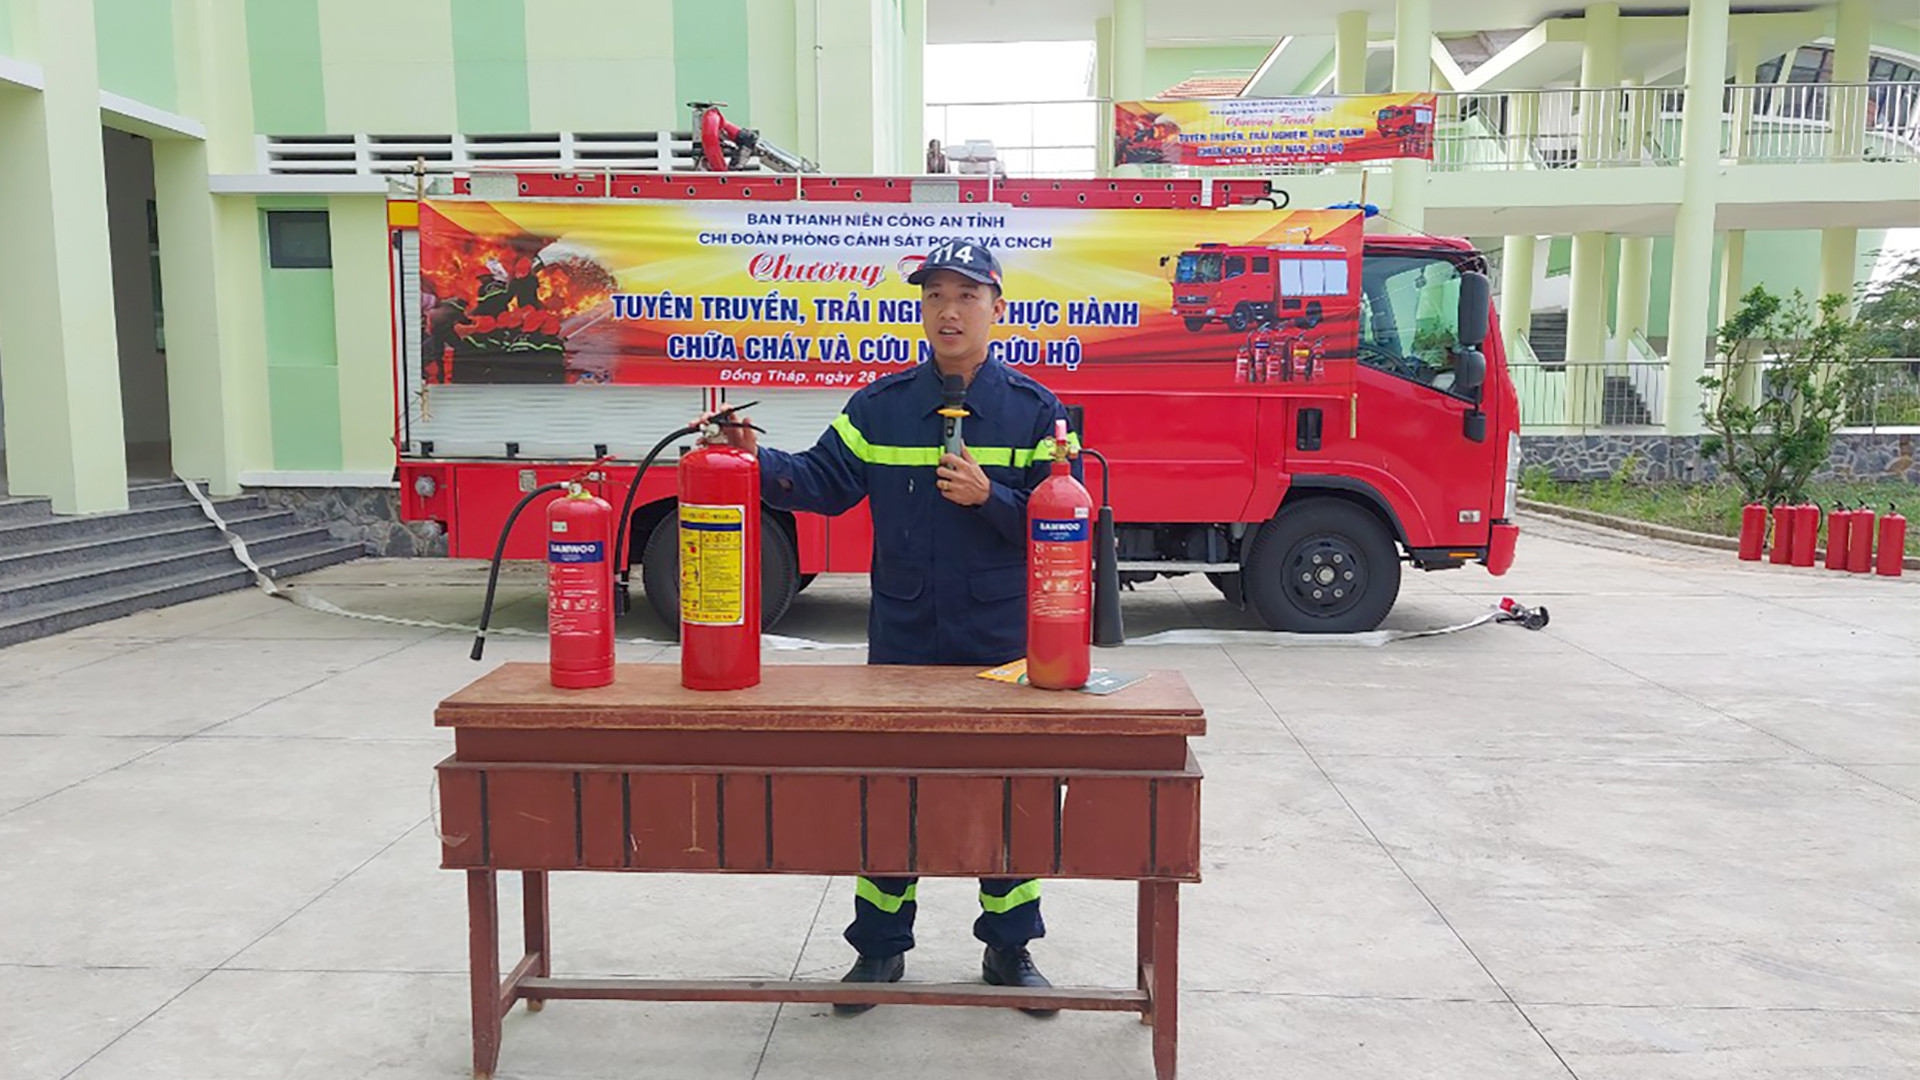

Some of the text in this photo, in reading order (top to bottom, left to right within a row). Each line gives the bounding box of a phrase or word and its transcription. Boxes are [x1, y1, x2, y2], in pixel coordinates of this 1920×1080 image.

[747, 213, 781, 225] BAN
[785, 214, 842, 226] THANH
[845, 212, 883, 227] NIÊN
[887, 212, 935, 227] CÔNG
[940, 216, 963, 227] AN
[699, 233, 727, 244] CHI
[731, 231, 778, 245] ĐOÀN
[782, 231, 840, 246] PHÒNG
[844, 232, 889, 247] CẢNH
[893, 233, 924, 247] SÁT
[979, 234, 1002, 248] VÀ
[1005, 237, 1052, 248] CNCH
[933, 243, 974, 264] 114
[748, 252, 885, 289] Chương
[612, 291, 693, 319] TUYÊN
[700, 290, 806, 325] TRUYỀN,
[814, 292, 870, 322] TRẢI
[1068, 296, 1139, 326] HÀNH
[668, 330, 738, 360] CHỮA
[745, 332, 811, 361] CHÁY
[818, 333, 851, 361] VÀ
[859, 334, 910, 362] CỨU
[988, 336, 1039, 364] CỨU
[1046, 335, 1082, 370] HỘ
[768, 369, 810, 384] Tháp,
[814, 372, 854, 385] ngày
[857, 371, 876, 383] 28
